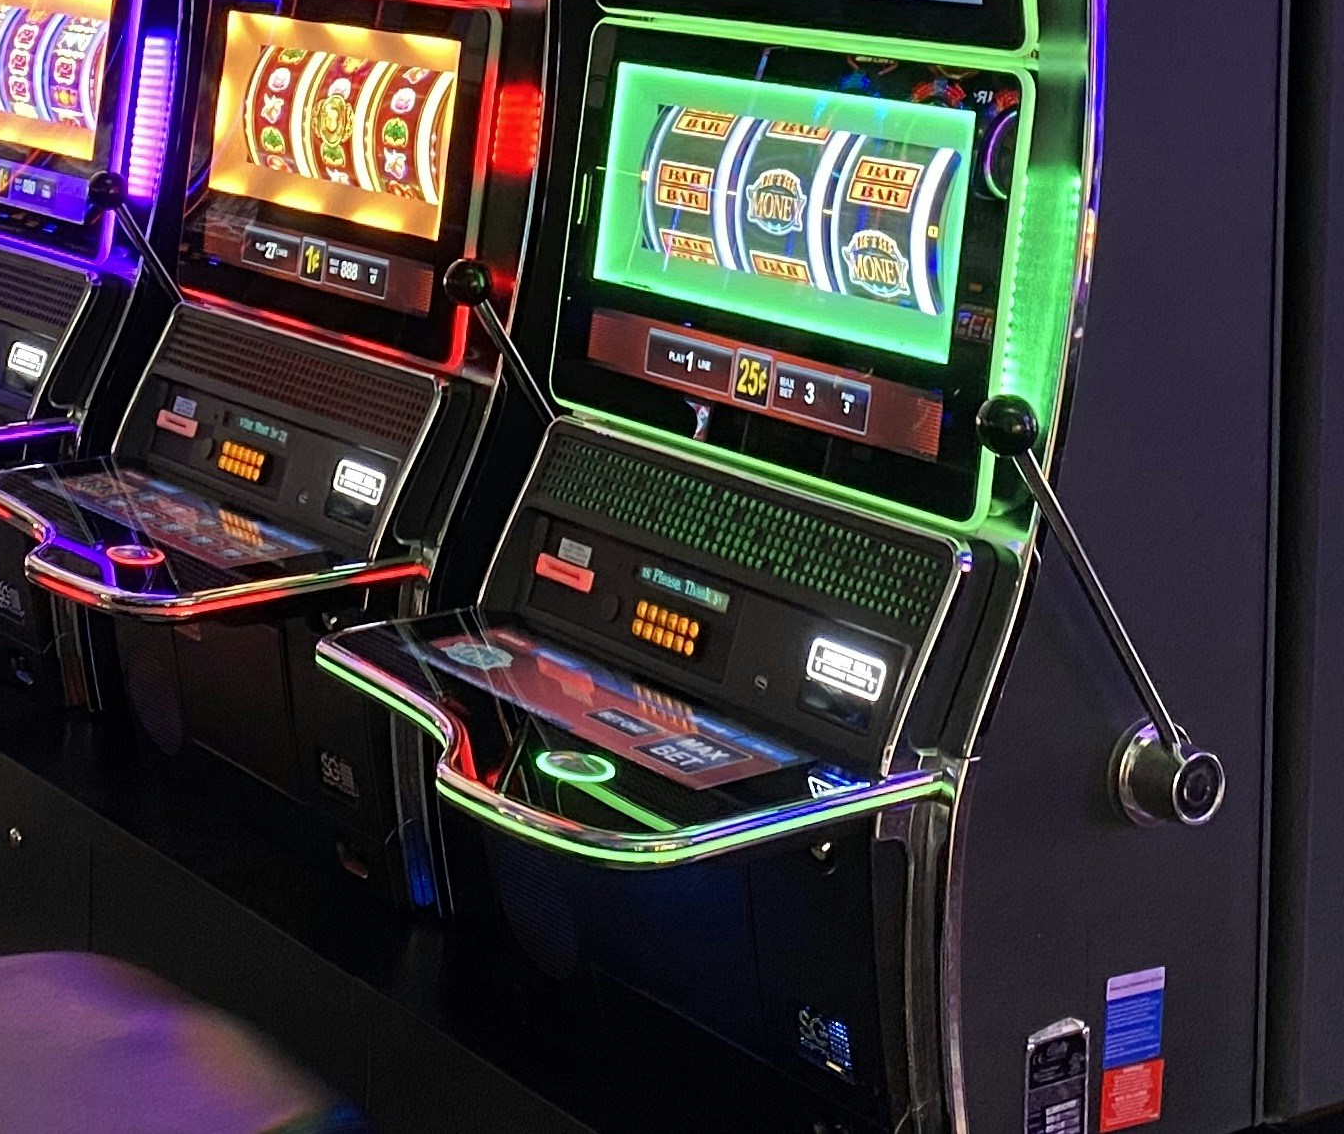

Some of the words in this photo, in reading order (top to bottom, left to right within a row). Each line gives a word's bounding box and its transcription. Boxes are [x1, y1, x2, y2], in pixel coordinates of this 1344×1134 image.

[683, 117, 723, 136] BAR
[666, 166, 706, 185] BAR
[864, 162, 912, 182] BAR
[664, 187, 704, 207] BAR
[750, 188, 807, 220] MONEY
[859, 183, 903, 205] BAR
[264, 241, 278, 260] 27
[759, 257, 801, 278] BAR
[849, 252, 907, 287] MONEY
[686, 351, 694, 372] 1
[736, 357, 768, 397] 25¢
[804, 382, 816, 405] 3
[842, 401, 850, 415] 3
[649, 744, 706, 767] BET
[676, 738, 731, 761] MAX
